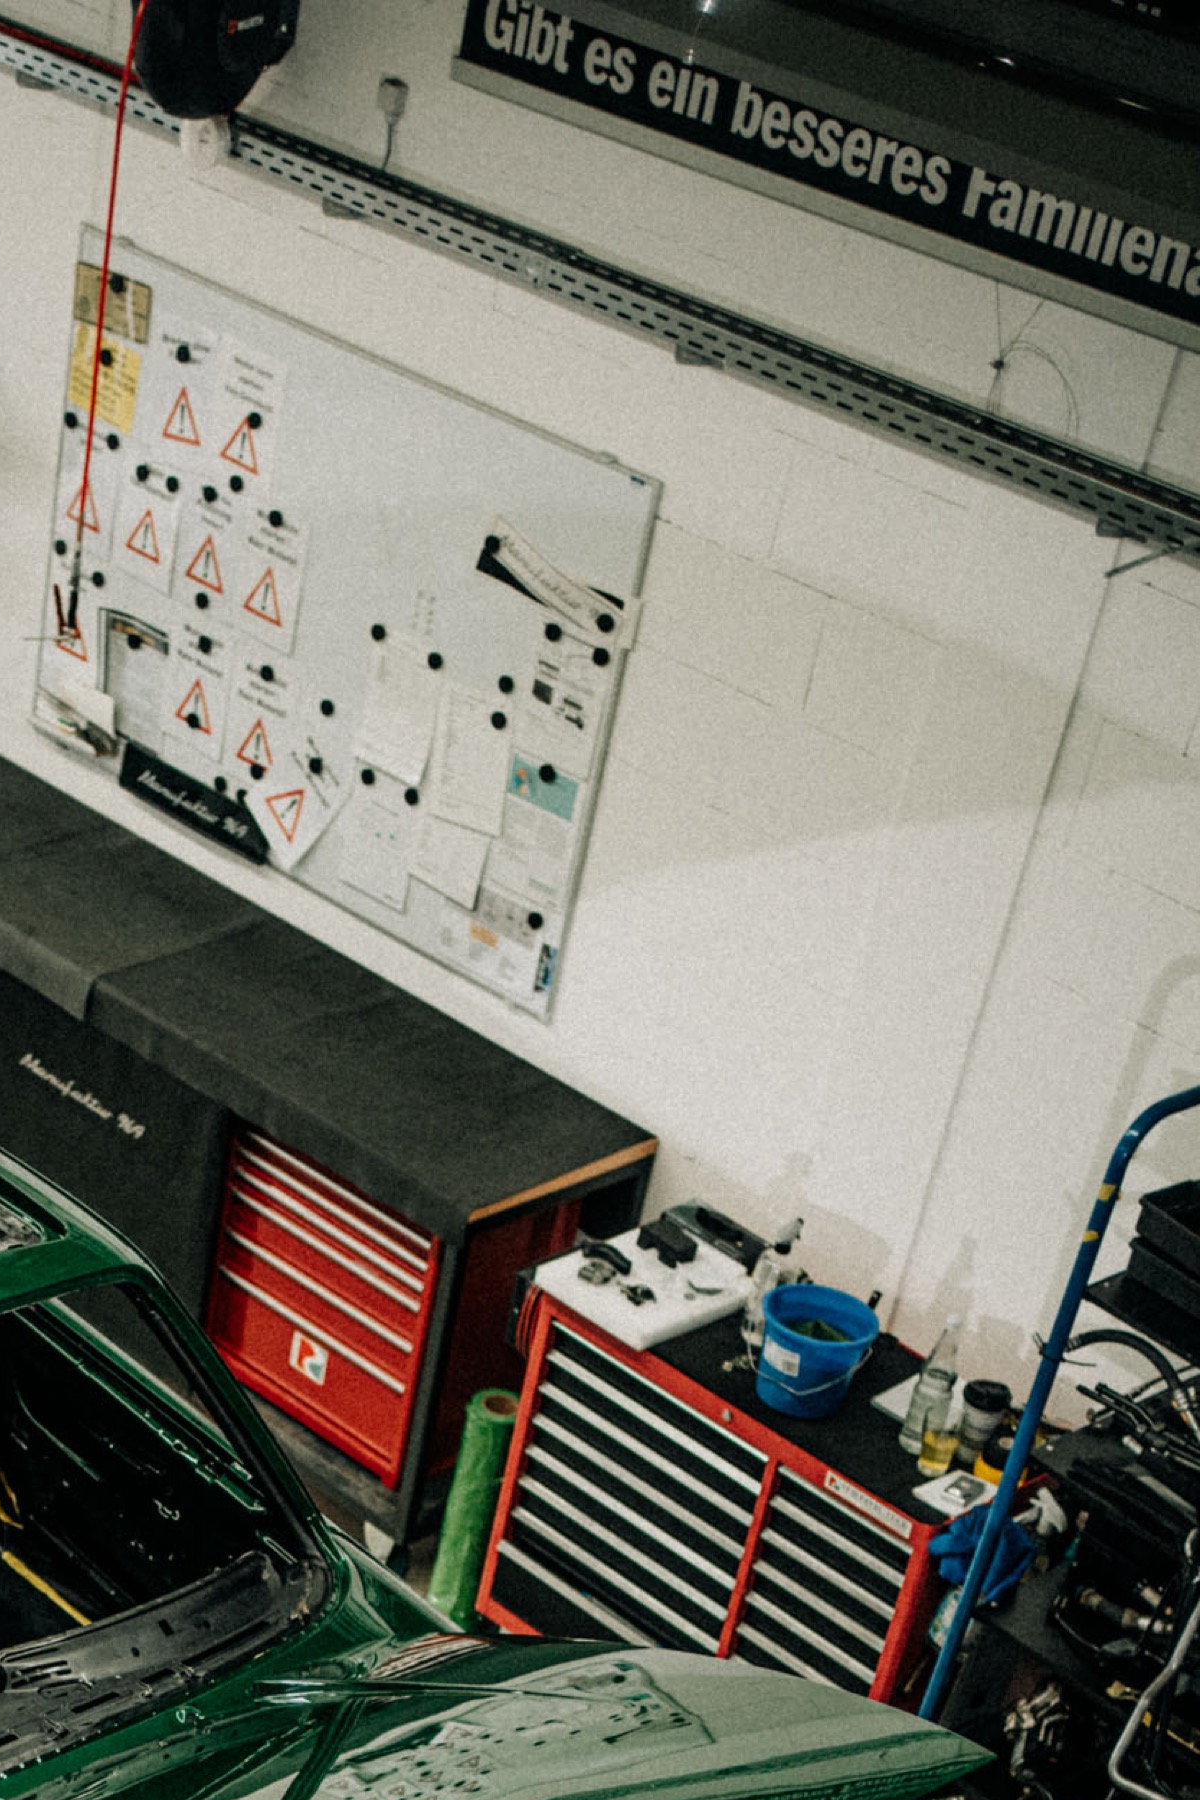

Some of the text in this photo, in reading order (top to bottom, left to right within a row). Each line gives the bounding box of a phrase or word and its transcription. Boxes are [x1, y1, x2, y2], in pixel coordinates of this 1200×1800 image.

[483, 0, 574, 75] Gibt
[584, 38, 637, 95] es
[648, 59, 719, 125] ein
[730, 80, 951, 206] besseres
